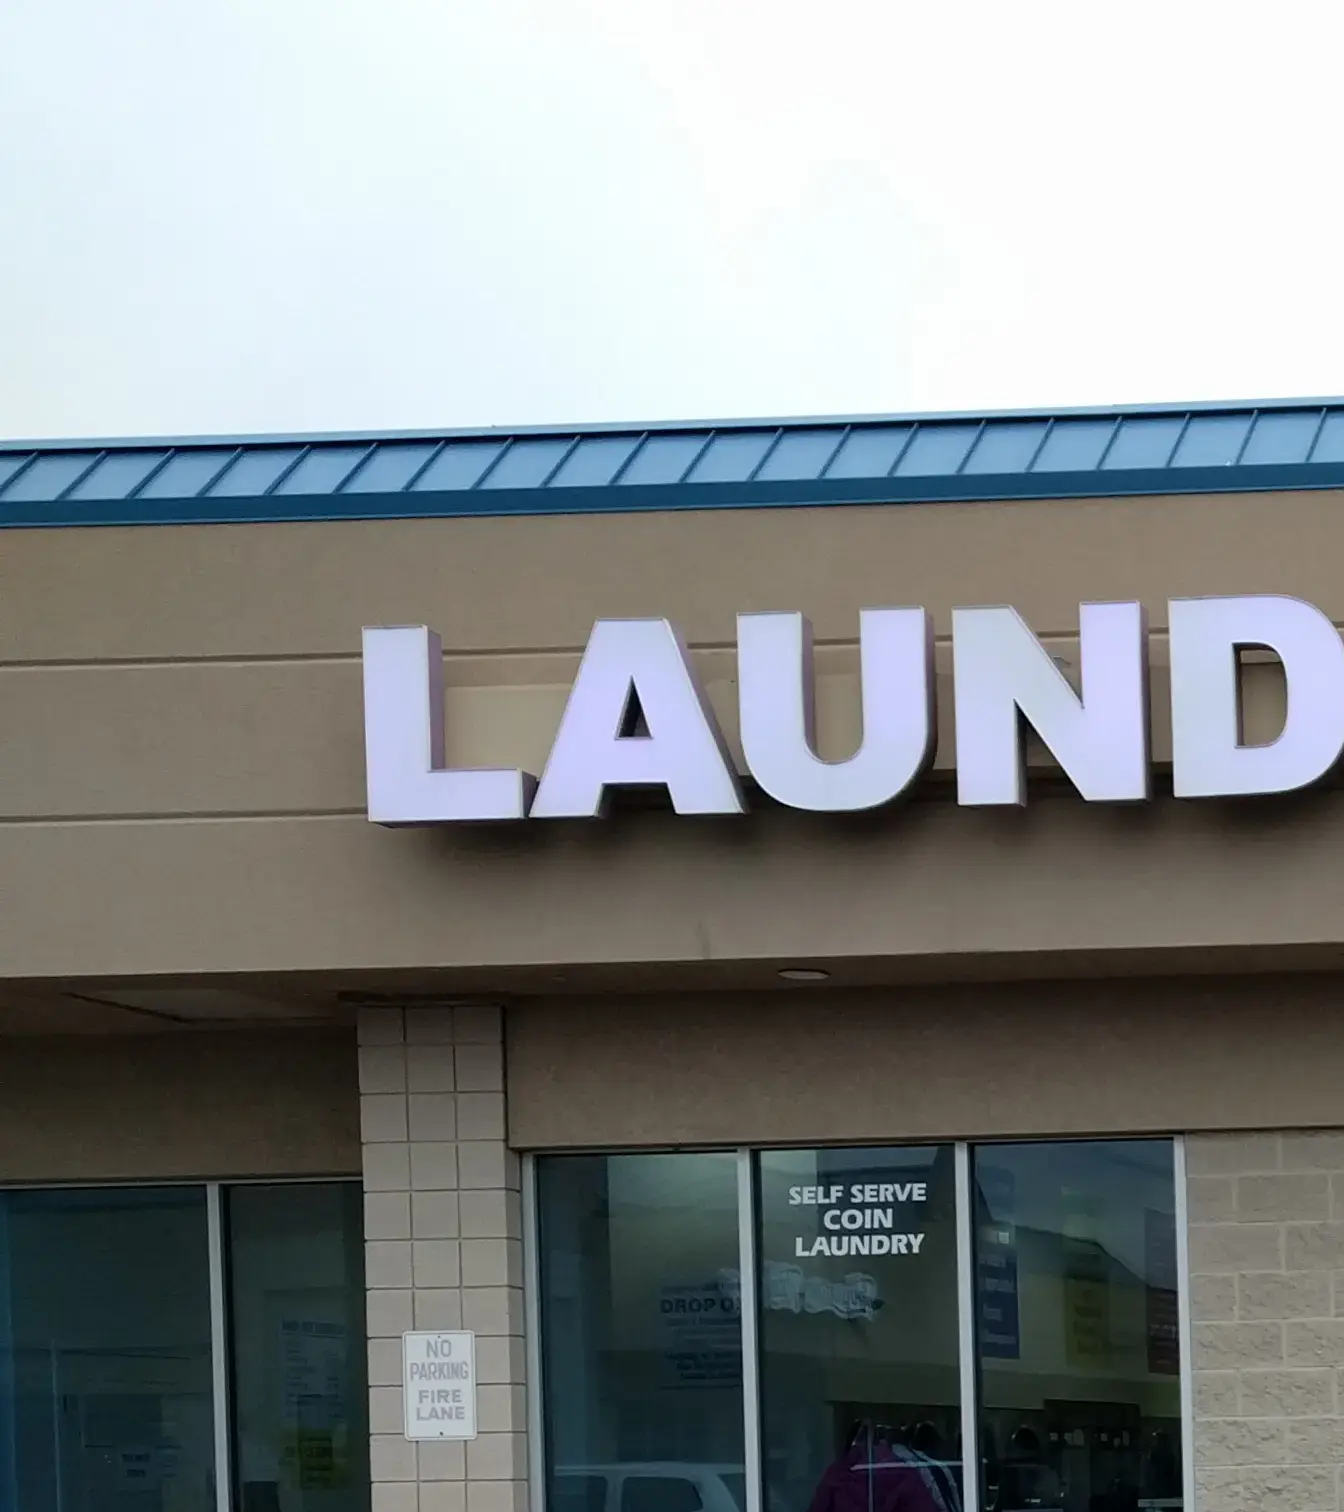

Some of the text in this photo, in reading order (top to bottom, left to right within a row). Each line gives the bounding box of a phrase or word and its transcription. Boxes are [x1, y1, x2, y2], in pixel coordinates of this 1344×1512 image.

[788, 1183, 927, 1205] SELF SERVE
[823, 1208, 893, 1230] COIN
[795, 1233, 925, 1257] LAUNDRY
[426, 1340, 452, 1358] NO
[410, 1361, 470, 1381] PARKING
[418, 1389, 463, 1404] FIRE
[416, 1406, 466, 1421] LANE
